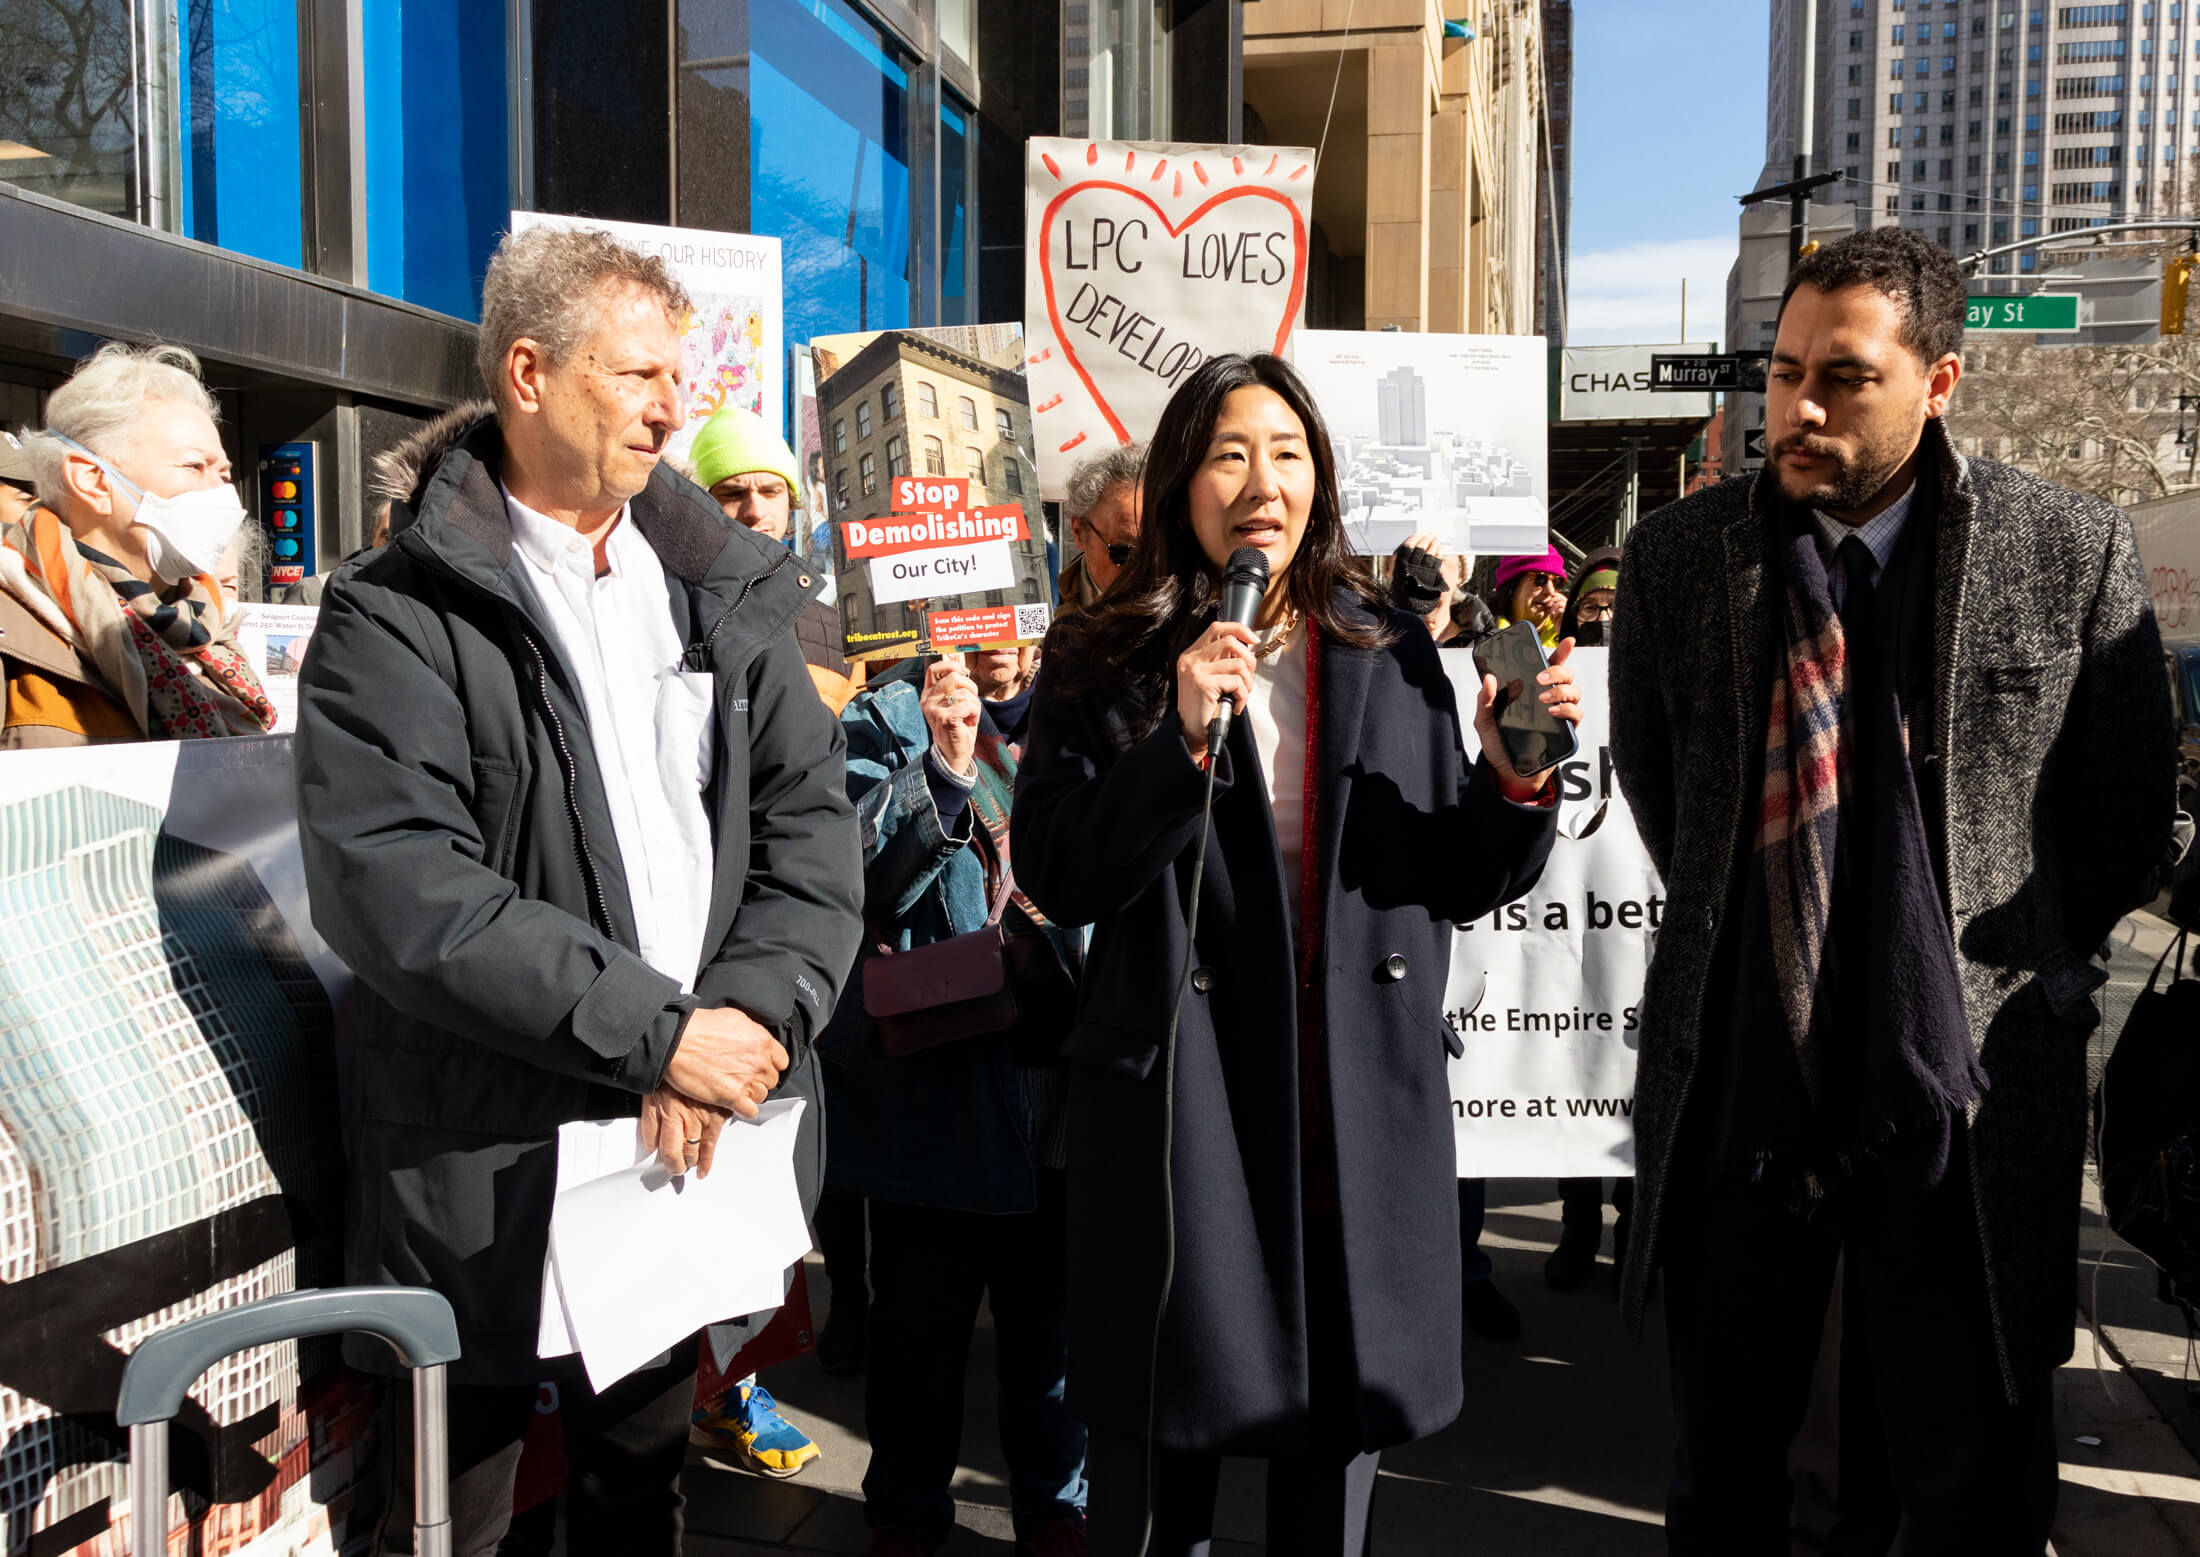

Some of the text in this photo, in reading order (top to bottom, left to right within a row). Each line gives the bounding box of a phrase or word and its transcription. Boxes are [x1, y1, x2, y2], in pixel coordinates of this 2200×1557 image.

[660, 242, 695, 265] OUR
[701, 246, 767, 270] HISTORY
[1065, 218, 1287, 285] LPC LOVES
[2003, 302, 2025, 322] St
[1065, 282, 1213, 388] DEVELOP
[1659, 364, 1718, 385] Murray
[900, 481, 960, 509] Stop
[849, 511, 1018, 547] Demolishing
[272, 567, 300, 577] NYCE
[892, 554, 977, 579] Our City!
[261, 613, 290, 622] Seaport
[275, 622, 296, 630] Water
[934, 611, 1011, 625] Scan this code and sign
[948, 624, 975, 633] petition
[985, 621, 1009, 631] protect
[846, 629, 918, 643] tribecatrust.org
[969, 630, 1000, 639] character
[1543, 902, 1569, 931] a
[1445, 1007, 1496, 1032] the
[1507, 1006, 1613, 1038] Empire
[1526, 1095, 1558, 1117] at
